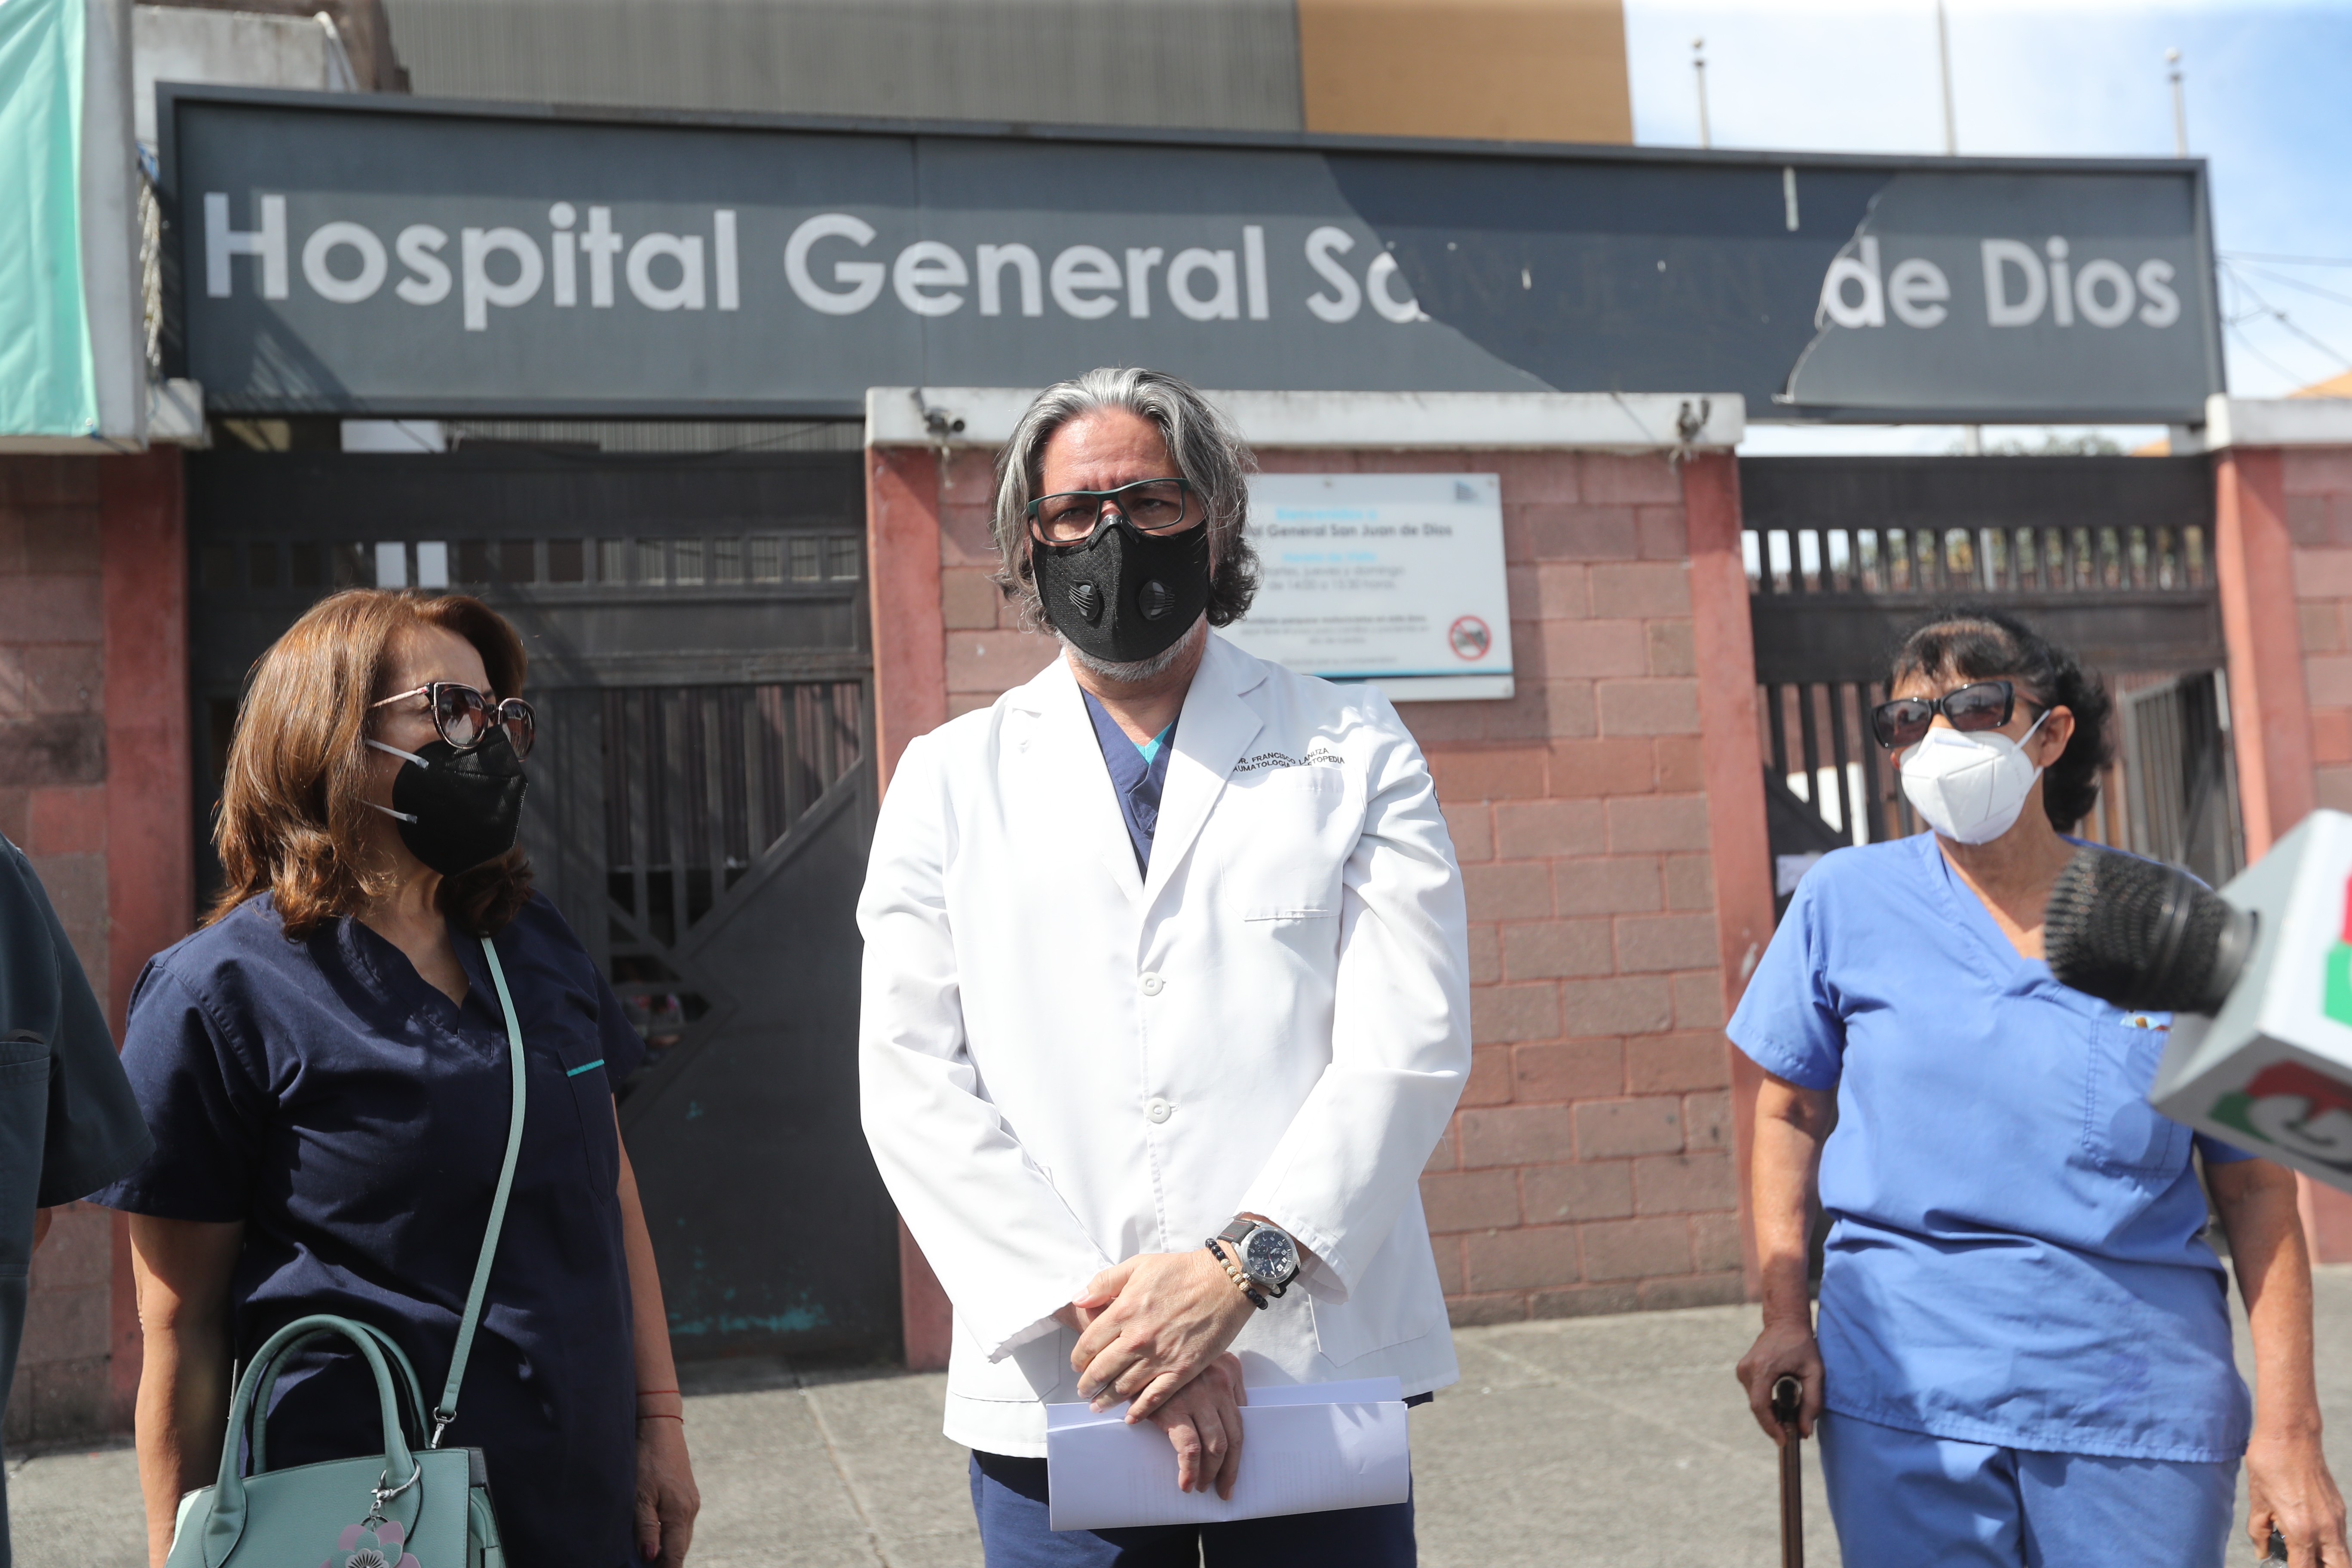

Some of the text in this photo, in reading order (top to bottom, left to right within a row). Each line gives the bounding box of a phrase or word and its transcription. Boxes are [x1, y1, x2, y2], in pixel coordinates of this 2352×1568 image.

[208, 196, 740, 330] Hospital
[784, 213, 1269, 321] General
[1305, 226, 1431, 323] Sa
[1822, 236, 1950, 328] de
[1981, 236, 2181, 328] Dios
[1267, 524, 1326, 536] General
[1330, 524, 1357, 537] San
[1362, 524, 1395, 537] Juan
[1400, 523, 1418, 537] de
[1422, 523, 1452, 537] Dios
[1233, 755, 1345, 772] AUMATOLOGIA RTOPEDIA
[1252, 752, 1296, 764] FRANCISCO
[1298, 747, 1329, 765] LANUZA
